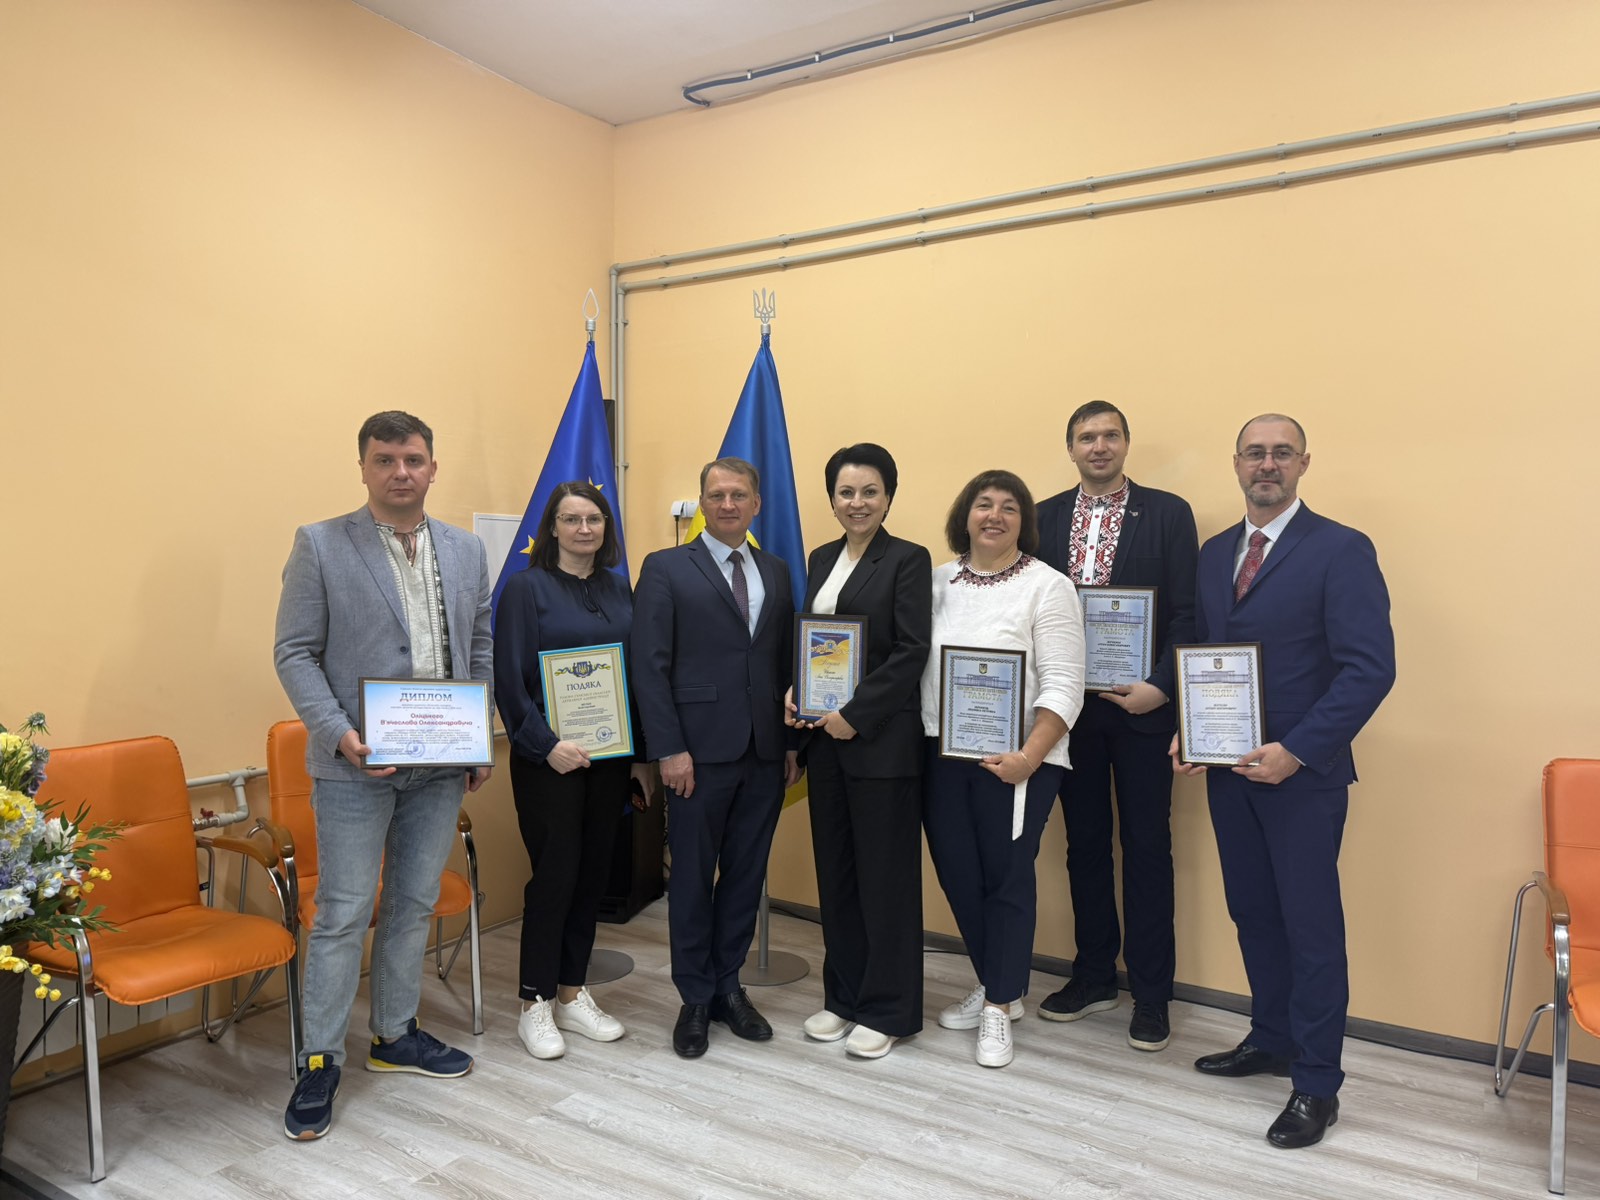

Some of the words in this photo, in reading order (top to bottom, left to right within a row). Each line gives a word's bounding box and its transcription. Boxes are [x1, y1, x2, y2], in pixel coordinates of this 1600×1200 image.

[1095, 626, 1135, 636] ГРАМОТА
[566, 681, 602, 691] ПОДЯКА
[400, 692, 453, 702] ДИПЛОМ
[963, 691, 1003, 702] ГРАМОТА
[1201, 689, 1239, 698] ПОДЯКА
